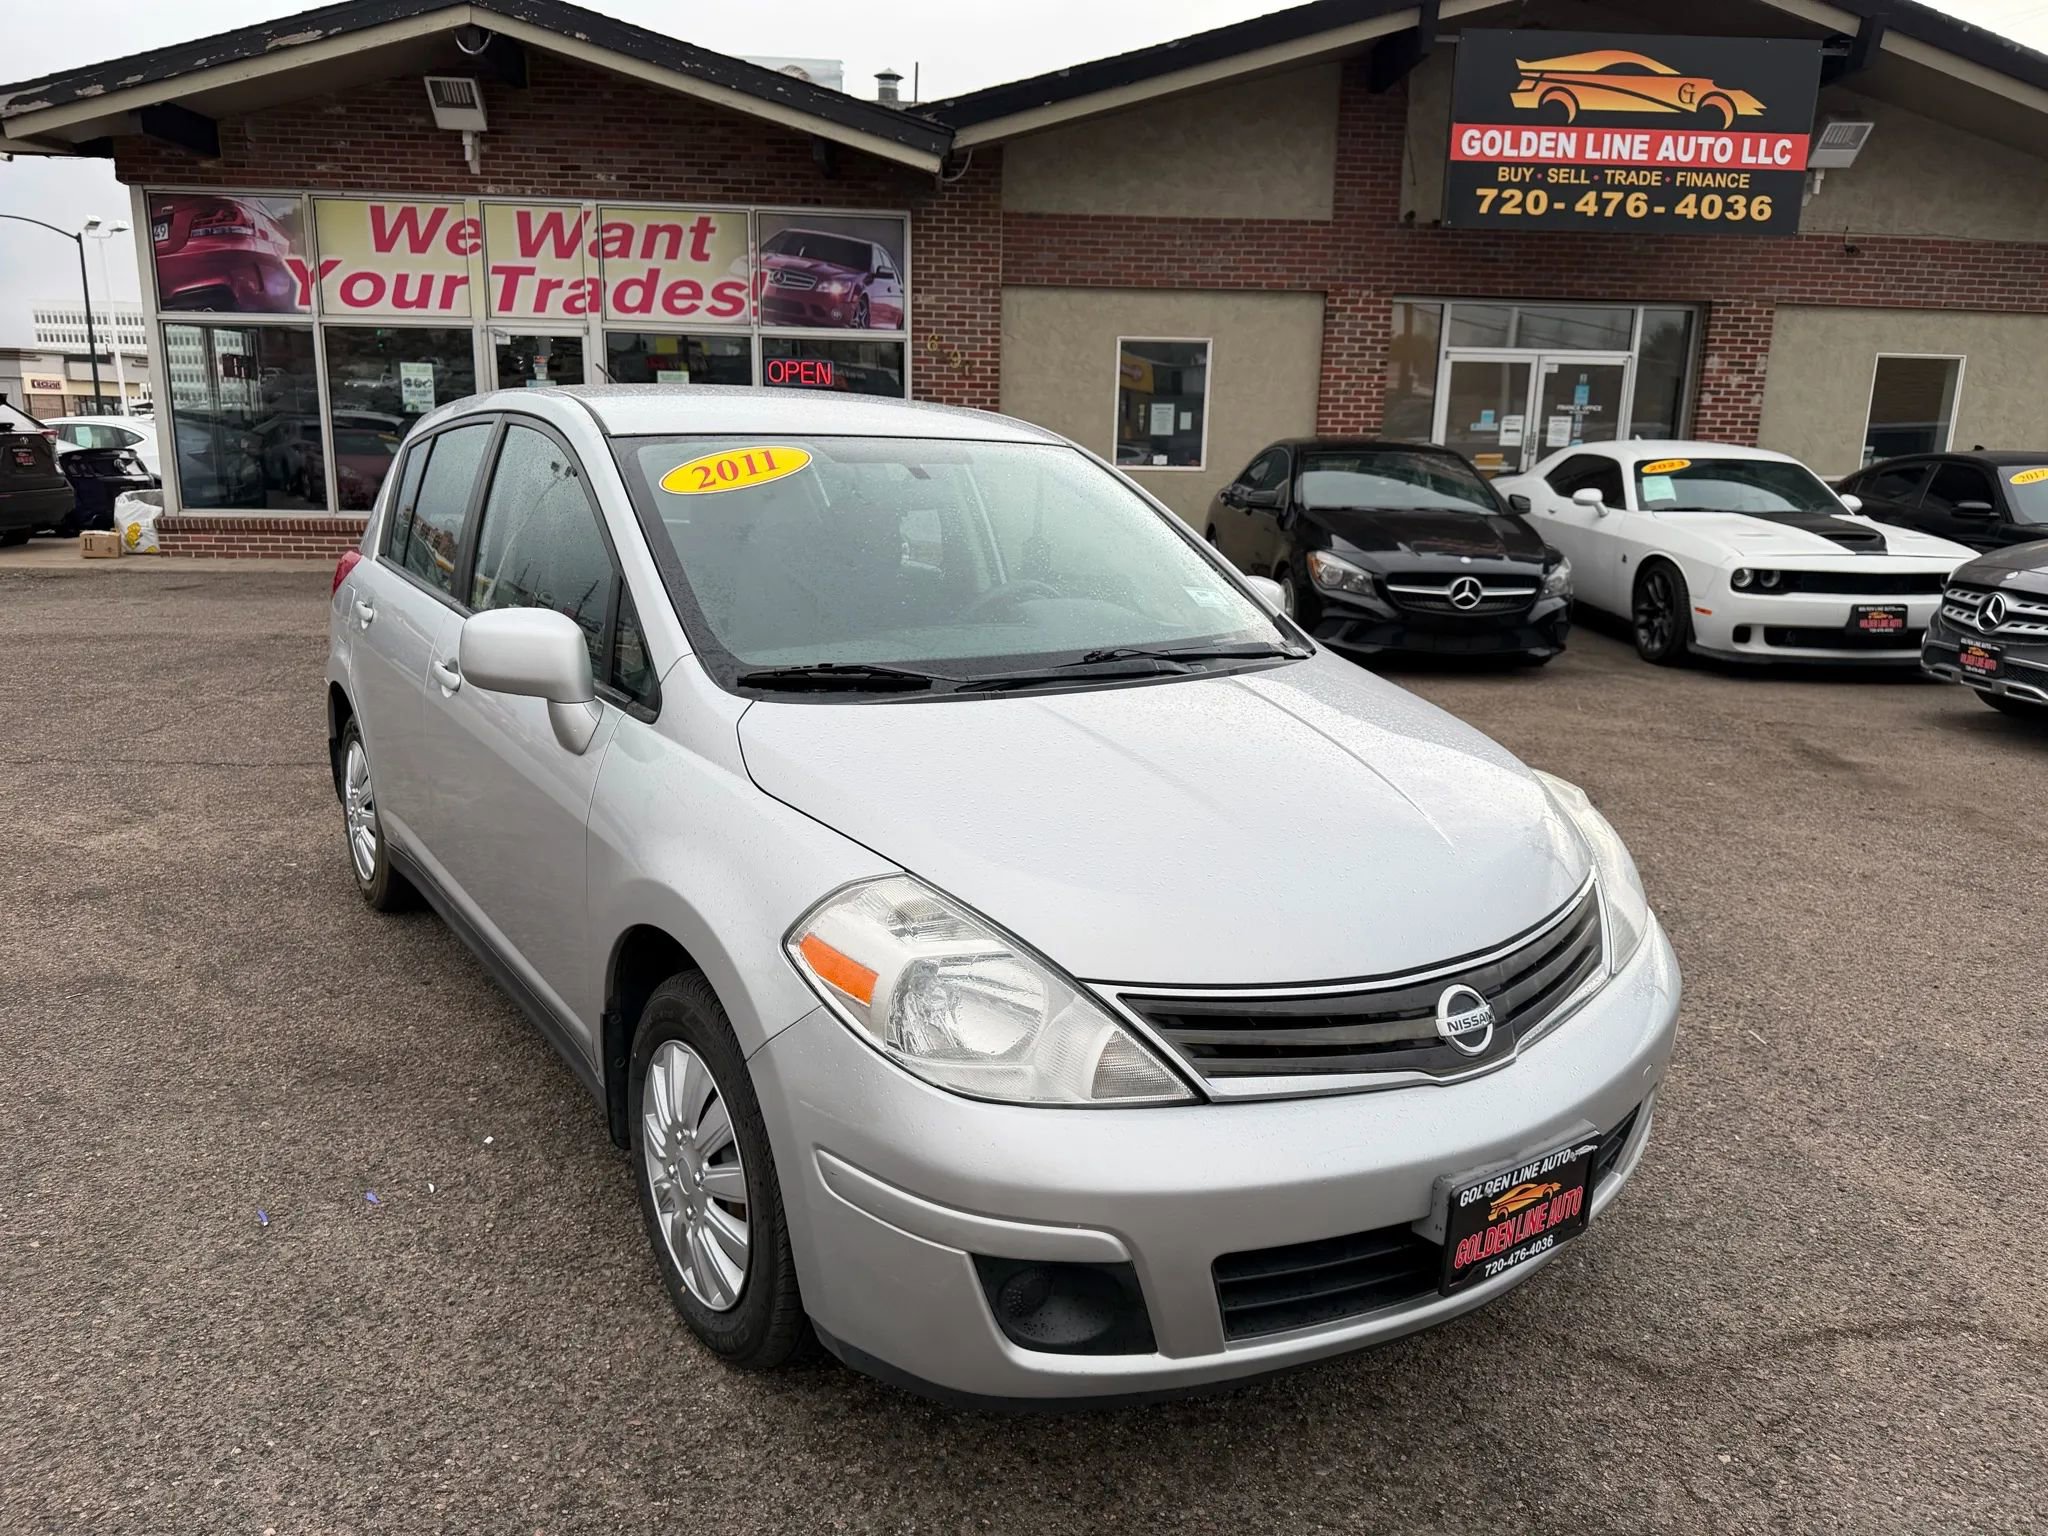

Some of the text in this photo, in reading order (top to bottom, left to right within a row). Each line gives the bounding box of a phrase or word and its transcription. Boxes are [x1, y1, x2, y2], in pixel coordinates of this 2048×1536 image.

[1461, 128, 1793, 166] GOLDEN LINE AUTO LLC
[1497, 166, 1750, 189] BUY SELL TRADE FINANCE
[369, 205, 716, 263] We Want
[285, 259, 768, 318] Your Trades!
[767, 359, 833, 385] OPEN
[691, 450, 780, 490] 2011
[2019, 469, 2046, 483] 2017
[1447, 1011, 1493, 1032] NISSAN
[1460, 1149, 1571, 1207] GOLDEN LINE AUTO
[1454, 1185, 1584, 1269] GOLDEN LINE AUTO
[1485, 1234, 1554, 1278] 720-476-4036
